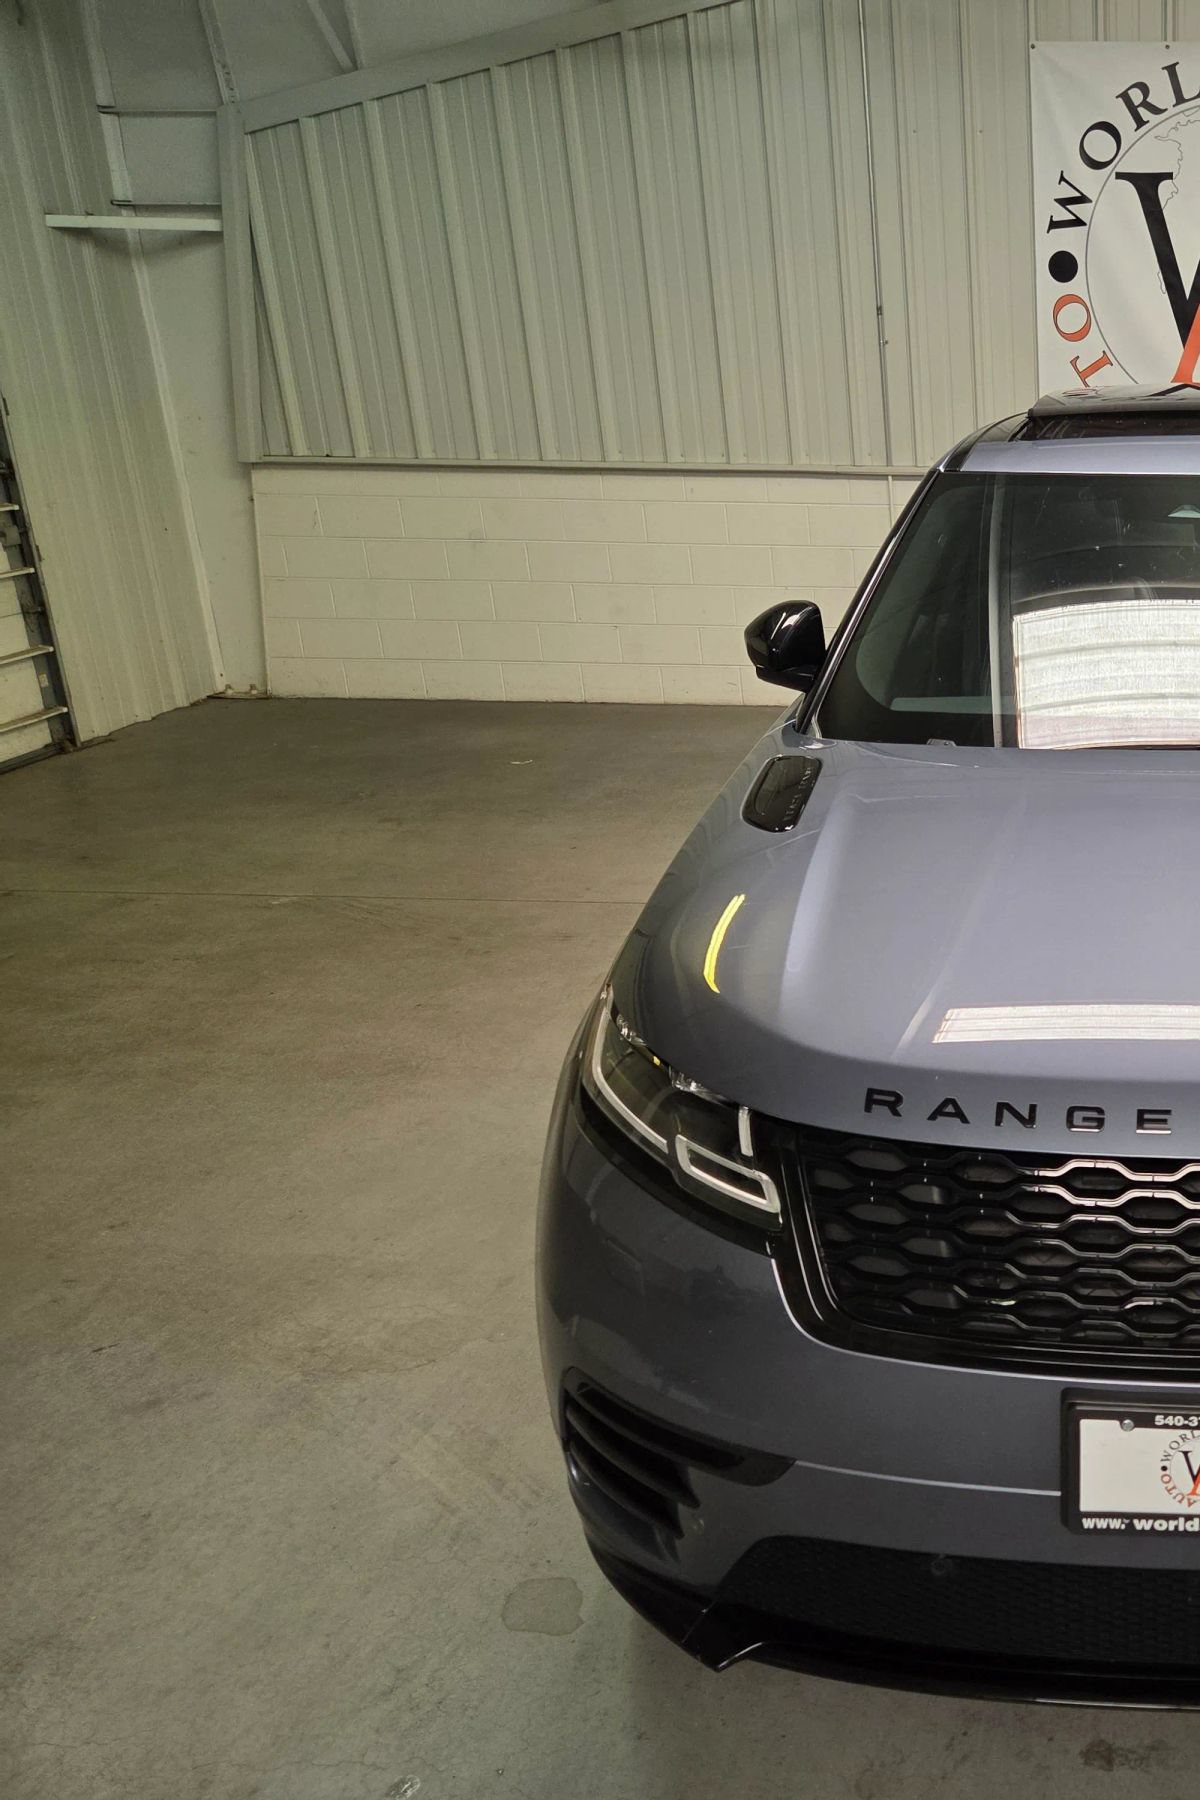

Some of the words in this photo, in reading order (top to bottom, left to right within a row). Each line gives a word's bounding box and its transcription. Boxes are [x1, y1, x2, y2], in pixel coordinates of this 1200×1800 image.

[1053, 293, 1113, 388] TO
[863, 1087, 1173, 1135] RANGE
[1160, 1473, 1197, 1508] AUTO
